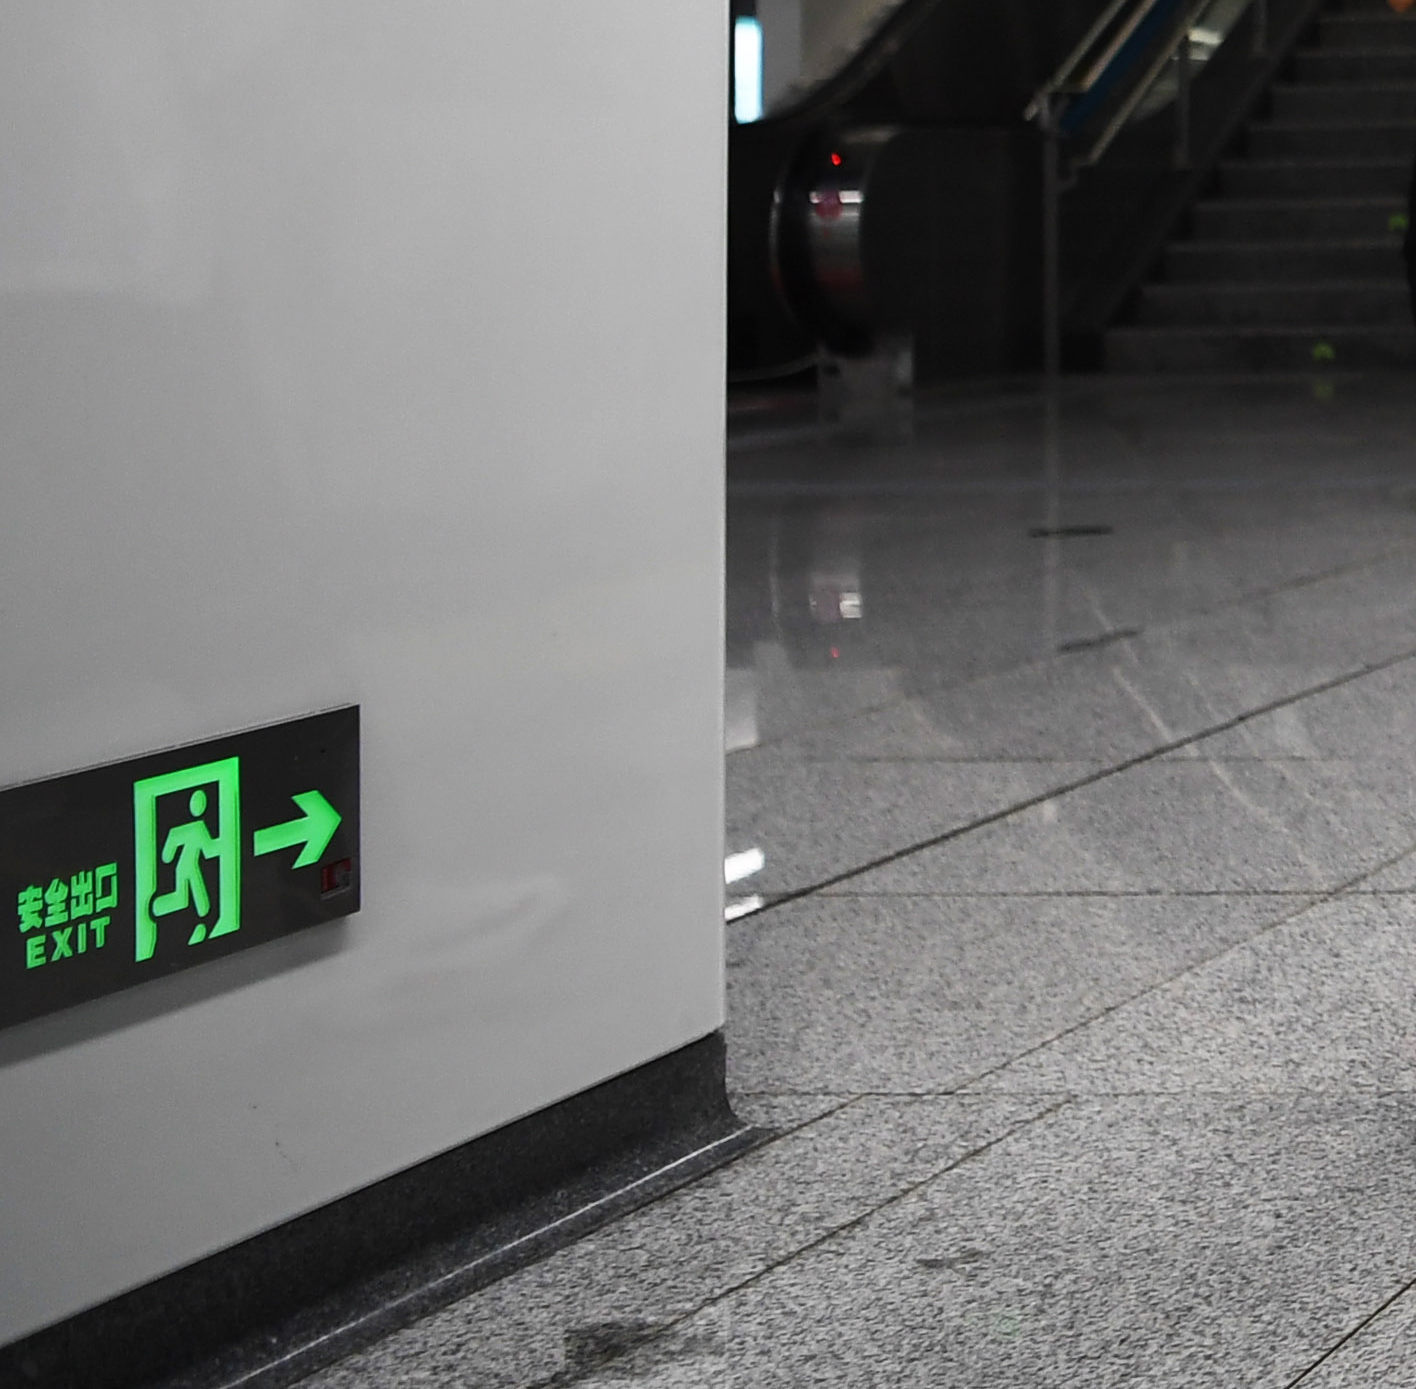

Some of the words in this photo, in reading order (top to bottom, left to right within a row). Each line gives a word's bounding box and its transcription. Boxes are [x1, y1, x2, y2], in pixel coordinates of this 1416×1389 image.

[17, 862, 117, 932] 安全出口
[26, 916, 111, 969] EXIT
